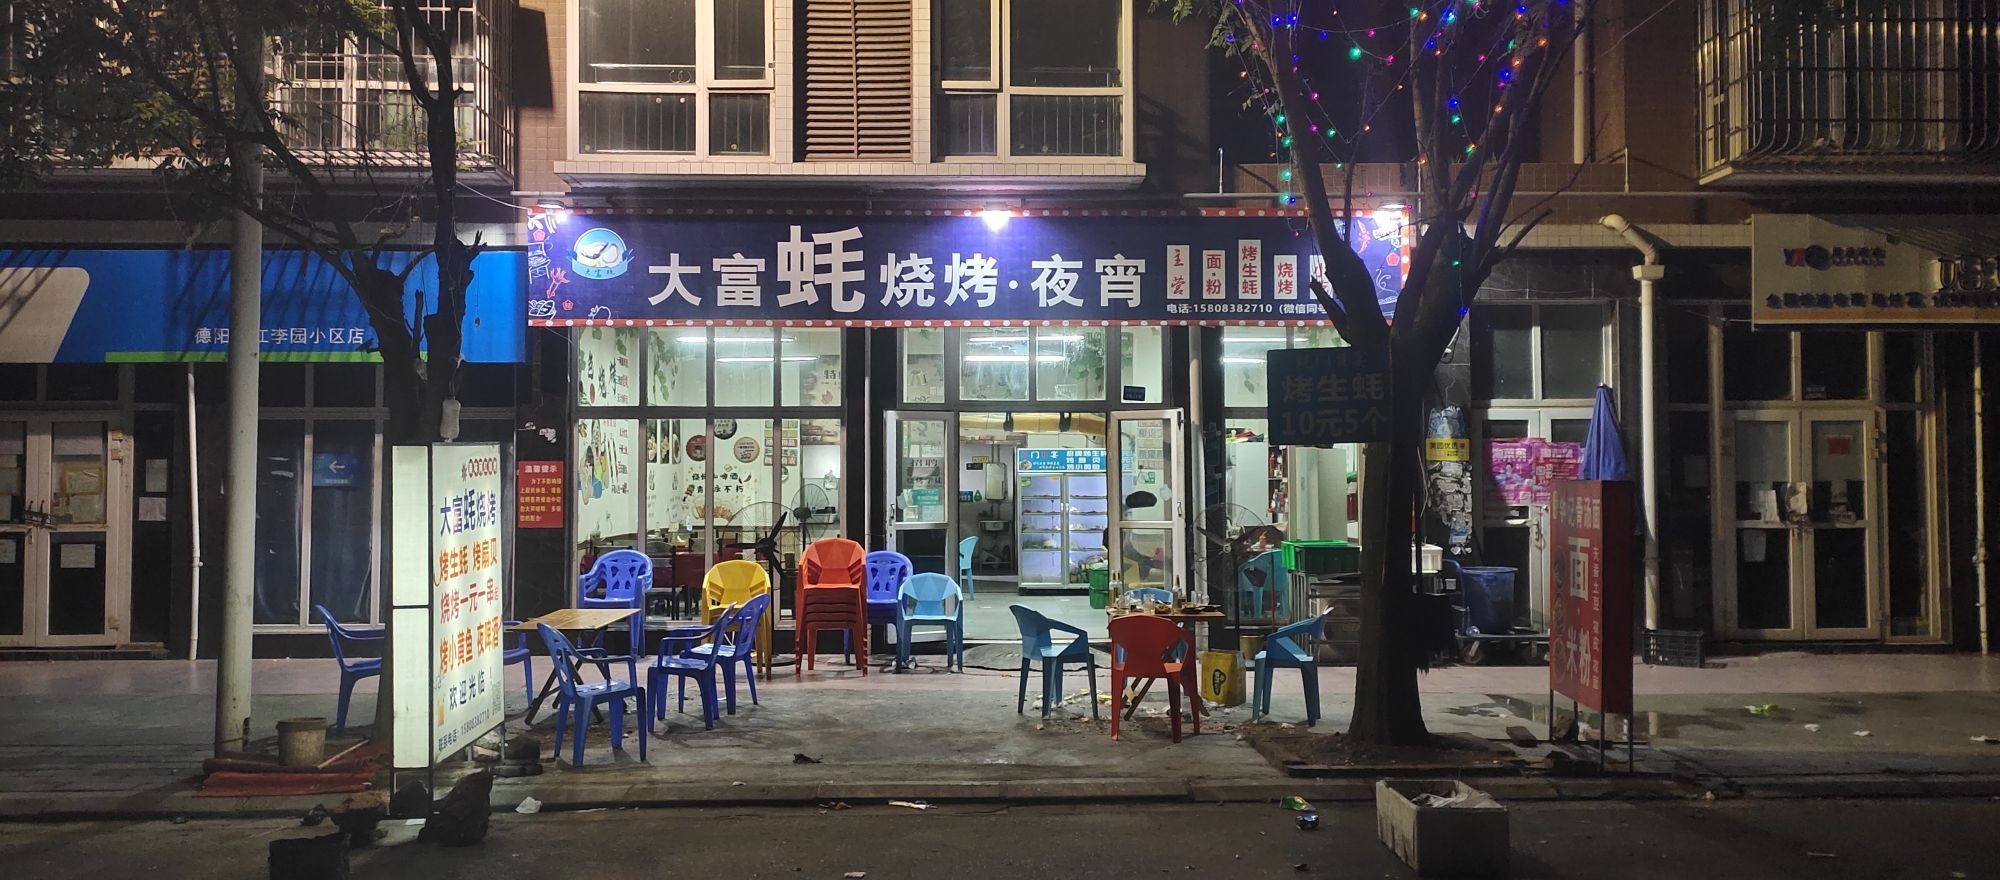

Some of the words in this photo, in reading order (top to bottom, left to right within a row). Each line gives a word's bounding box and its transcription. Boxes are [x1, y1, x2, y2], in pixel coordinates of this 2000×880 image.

[1171, 248, 1186, 296] 主营
[1242, 245, 1258, 295] 烤生蚝
[1278, 262, 1294, 295] 烧烤
[194, 327, 365, 345] 德阳江李园小区店
[1282, 373, 1385, 403] 烤生蚝
[1281, 406, 1387, 437] 10元5个
[439, 488, 497, 537] 大富蚝烧烤
[439, 544, 469, 581] 烤生蚝
[439, 626, 473, 675] 烤小黄鱼
